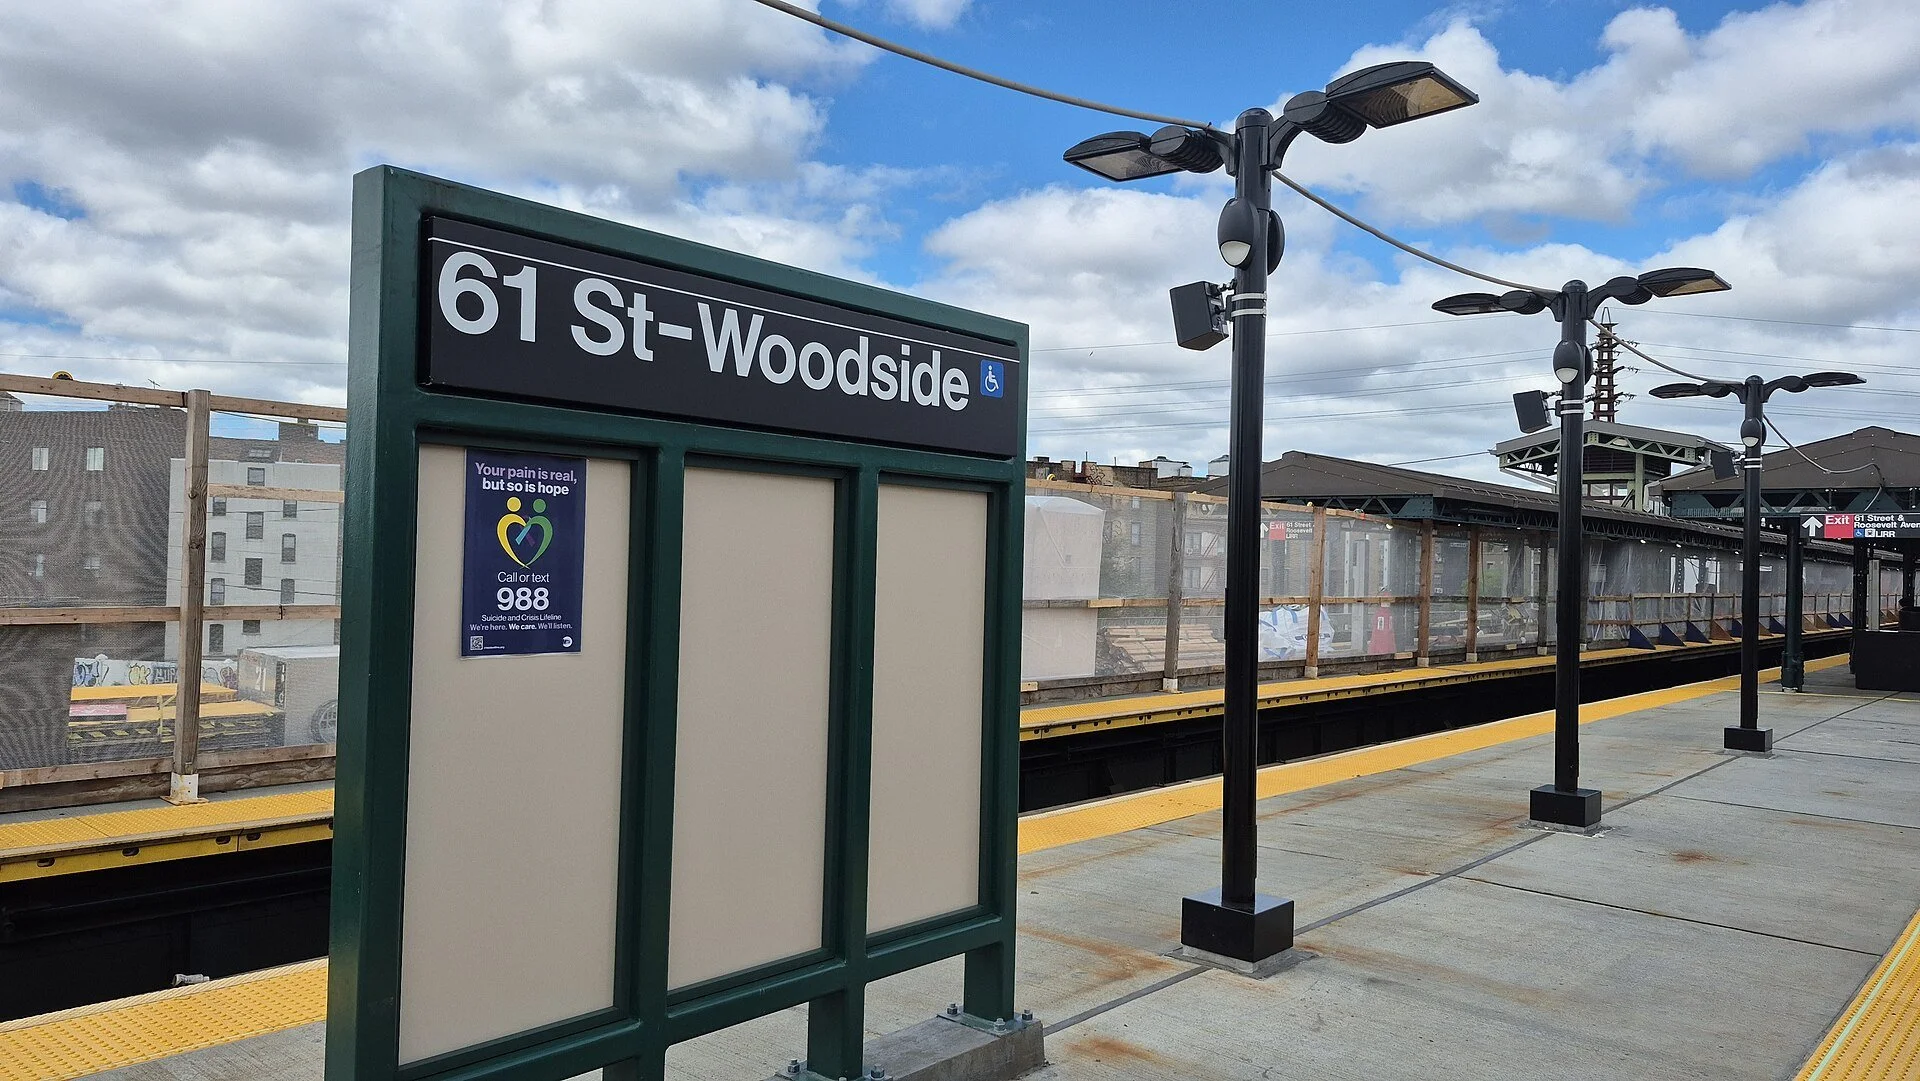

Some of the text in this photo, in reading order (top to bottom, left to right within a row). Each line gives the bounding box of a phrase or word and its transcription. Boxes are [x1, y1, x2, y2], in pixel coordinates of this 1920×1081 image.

[438, 250, 970, 411] 61 St-Woodside
[475, 462, 578, 484] Your pain is real,
[482, 478, 569, 496] but so is hope
[1825, 515, 1850, 525] Exit
[497, 572, 550, 583] Call or text
[496, 587, 550, 611] 988
